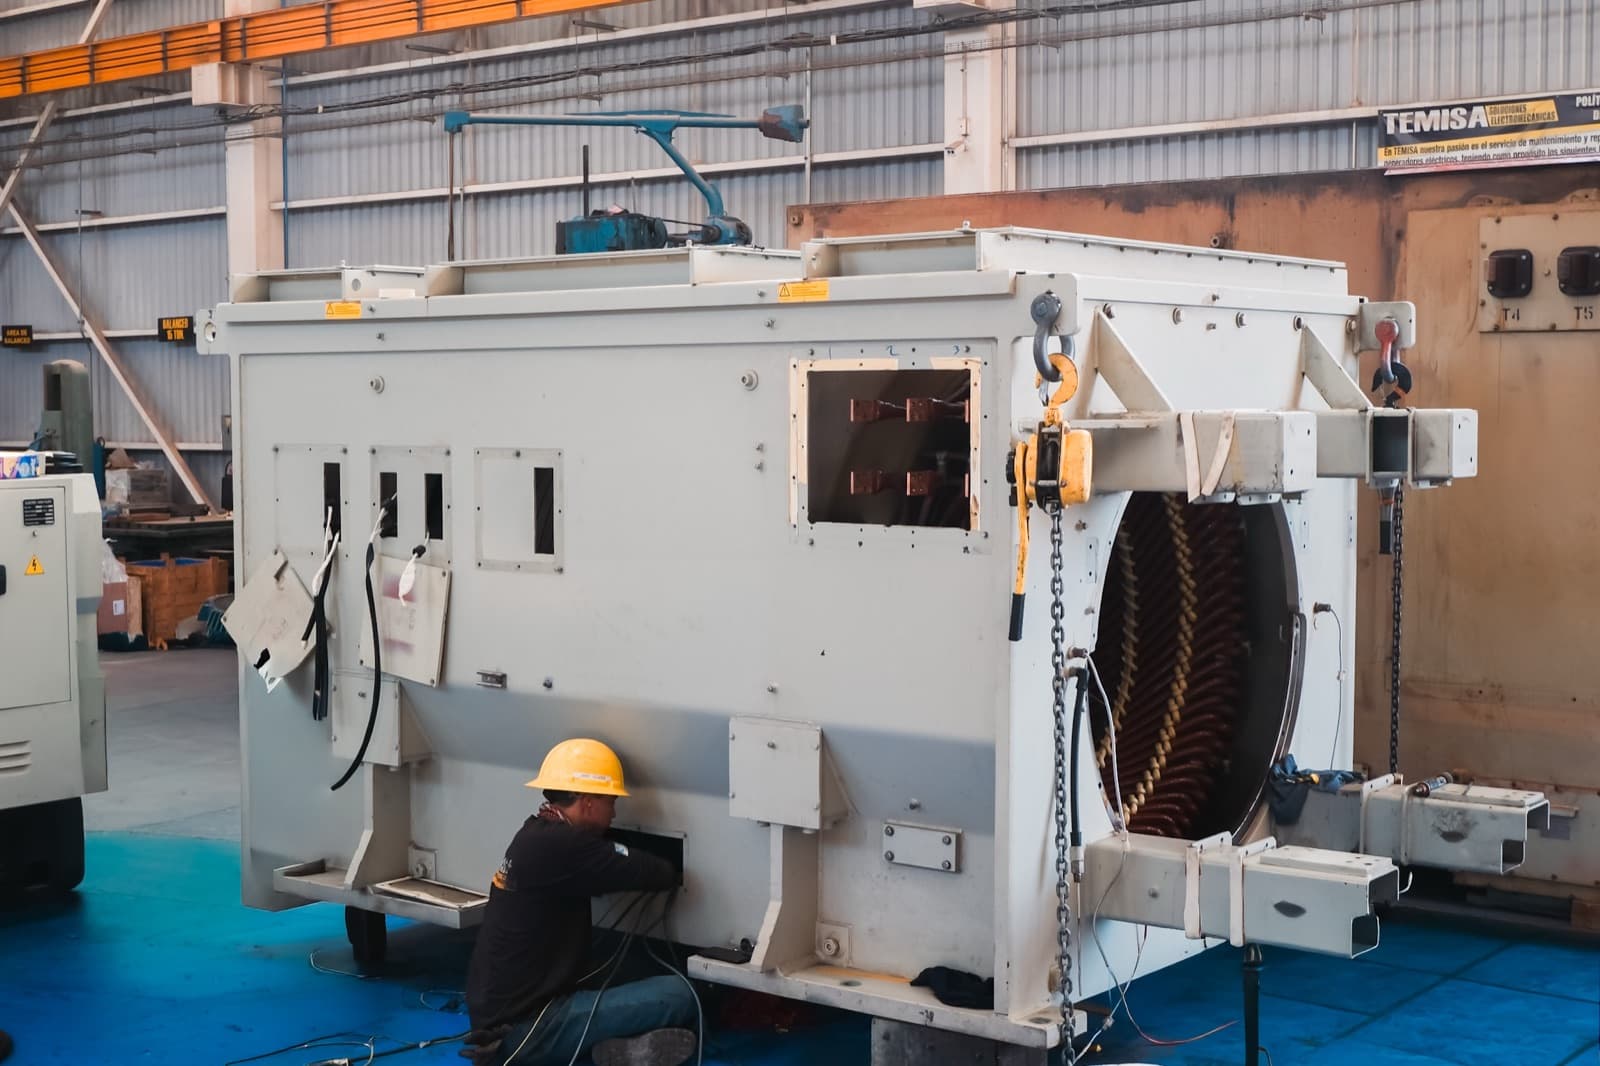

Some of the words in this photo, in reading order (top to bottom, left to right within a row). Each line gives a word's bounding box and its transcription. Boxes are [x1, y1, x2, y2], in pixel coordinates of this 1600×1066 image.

[1383, 105, 1488, 135] TEMISA
[1384, 148, 1392, 156] En
[1394, 146, 1418, 156] TEMISA
[1420, 145, 1445, 153] nuestra
[1447, 143, 1469, 153] pasión
[1481, 141, 1487, 149] el
[1489, 139, 1516, 149] servicio
[1519, 139, 1527, 147] de
[1529, 135, 1581, 146] mantenimiento
[1502, 308, 1520, 321] T4
[1573, 306, 1593, 320] T5
[886, 345, 899, 357] 2
